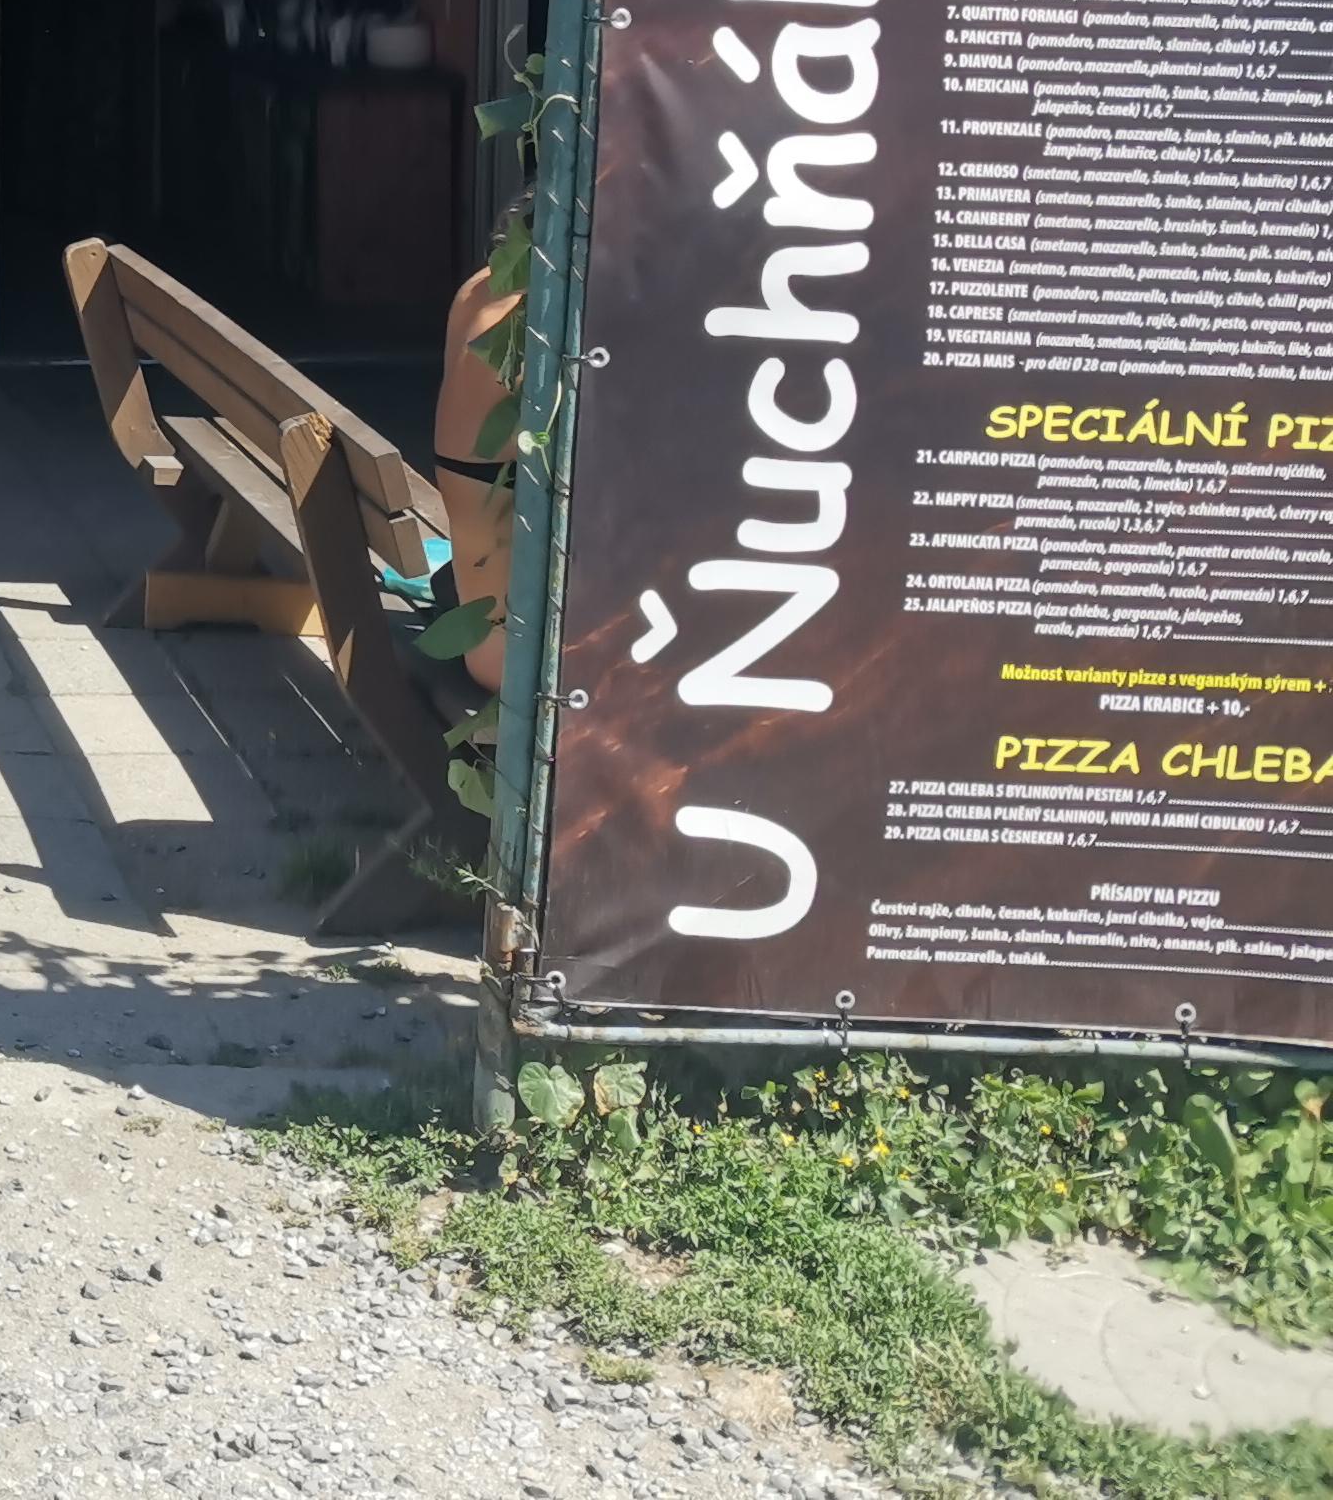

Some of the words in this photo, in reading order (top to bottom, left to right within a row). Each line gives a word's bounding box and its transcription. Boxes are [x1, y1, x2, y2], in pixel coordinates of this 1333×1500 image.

[985, 398, 1250, 448] SPECIÁLNÍ
[906, 575, 926, 589] 24.
[928, 575, 994, 592] ORTOLANA
[995, 577, 1031, 593] PIZZA
[1032, 579, 1099, 599] (pomodoro,
[1101, 583, 1168, 601] mozzarella,
[1169, 585, 1210, 603] rucola,
[1001, 663, 1063, 682] Možnost
[1065, 667, 1126, 687] varianty
[1128, 669, 1166, 688] pizze
[1168, 674, 1176, 686] s
[1178, 672, 1262, 693] veganským
[1264, 674, 1311, 695] sýrem
[1100, 694, 1141, 712] PIZZA
[1143, 696, 1204, 714] KRABICE
[993, 735, 1141, 776] PIZZA
[889, 781, 910, 796] 27.
[911, 781, 946, 796] PIZZA
[947, 783, 995, 798] CHLEBA
[996, 785, 1004, 798] S
[1005, 784, 1084, 802] BYLINKOVÝM
[1086, 788, 1134, 803] PESTEM
[884, 826, 905, 841] 29.
[906, 827, 941, 842] PIZZA
[942, 828, 990, 844] CHLEBA
[991, 830, 999, 844] S
[1000, 828, 1064, 846] ČESNEKEM
[667, 805, 818, 940] U
[1090, 882, 1153, 904] PŘÍSADY
[1153, 887, 1175, 905] NA
[1177, 889, 1221, 907] PIZZU
